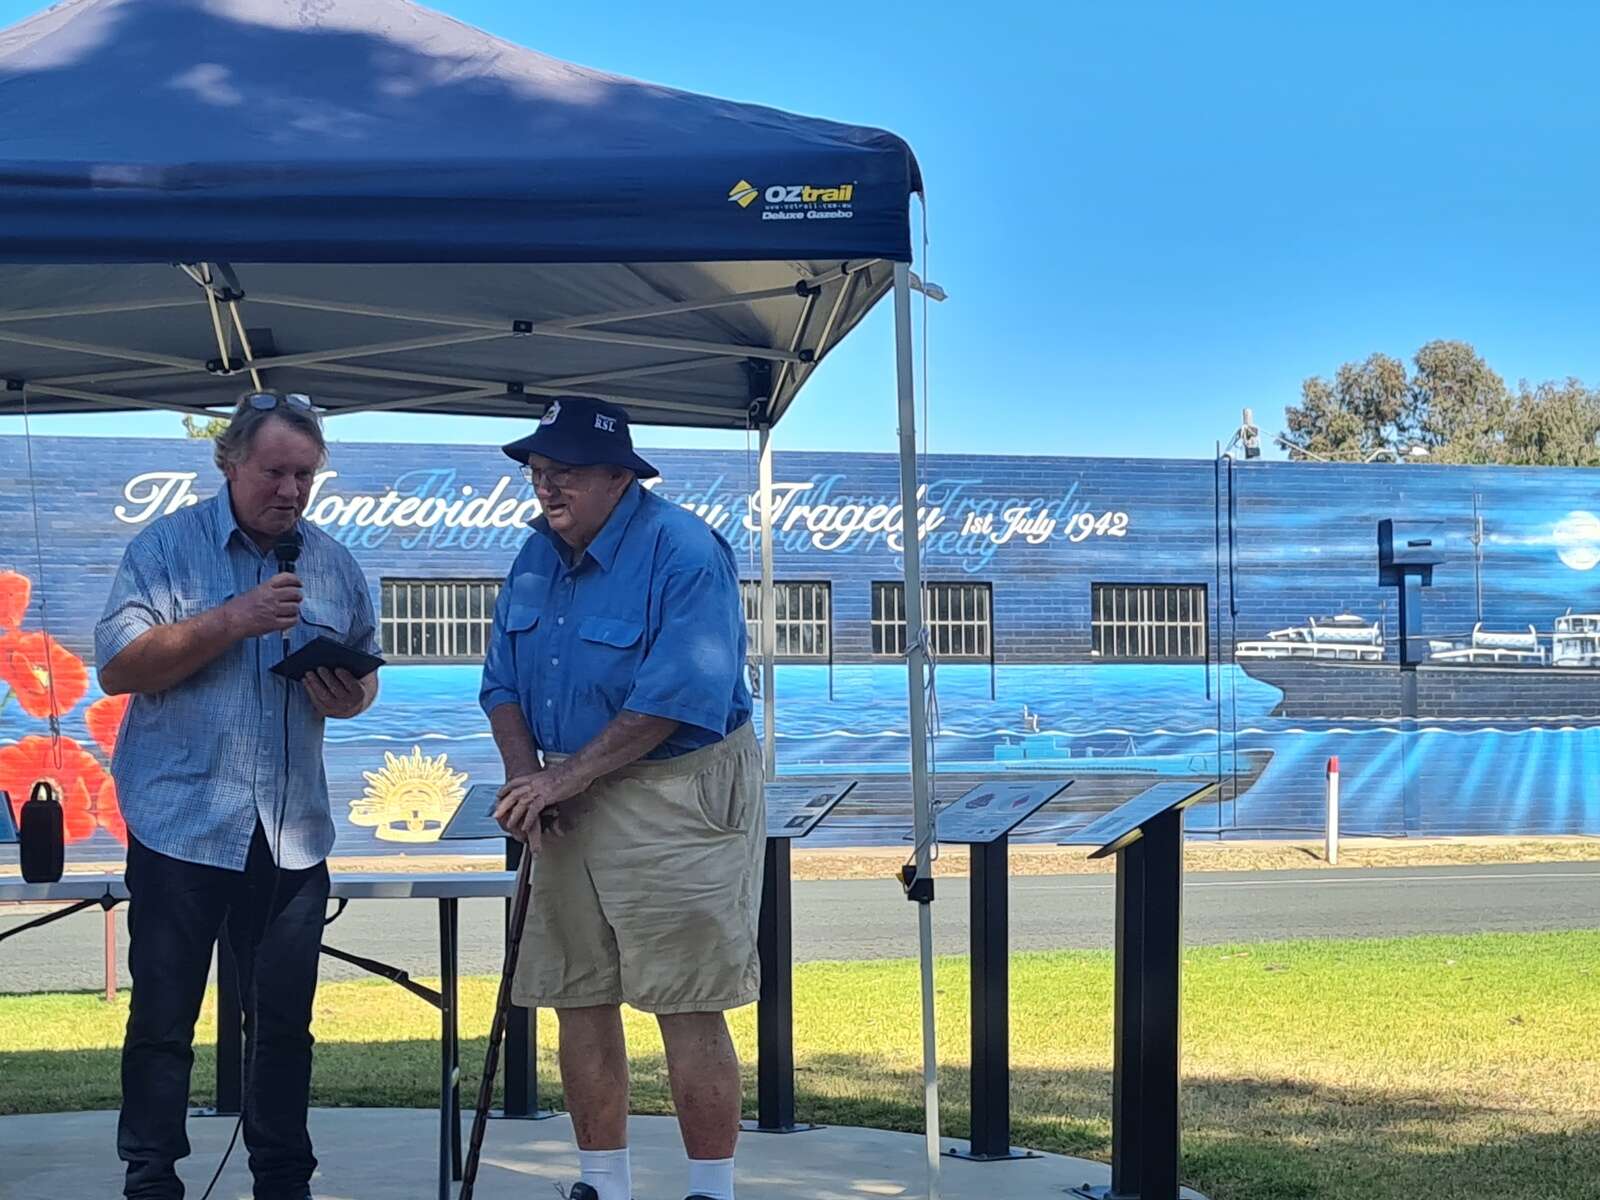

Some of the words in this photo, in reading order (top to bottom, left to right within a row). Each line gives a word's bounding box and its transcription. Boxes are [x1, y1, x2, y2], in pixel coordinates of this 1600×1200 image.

[765, 184, 853, 203] OZtrail
[762, 211, 804, 220] Deluxe
[807, 210, 853, 219] Gazebo
[595, 417, 616, 433] RSL
[113, 471, 199, 524] Th
[742, 482, 946, 551] Tragedy
[961, 511, 995, 537] 1st
[989, 506, 1057, 545] July
[1063, 511, 1129, 543] 1942
